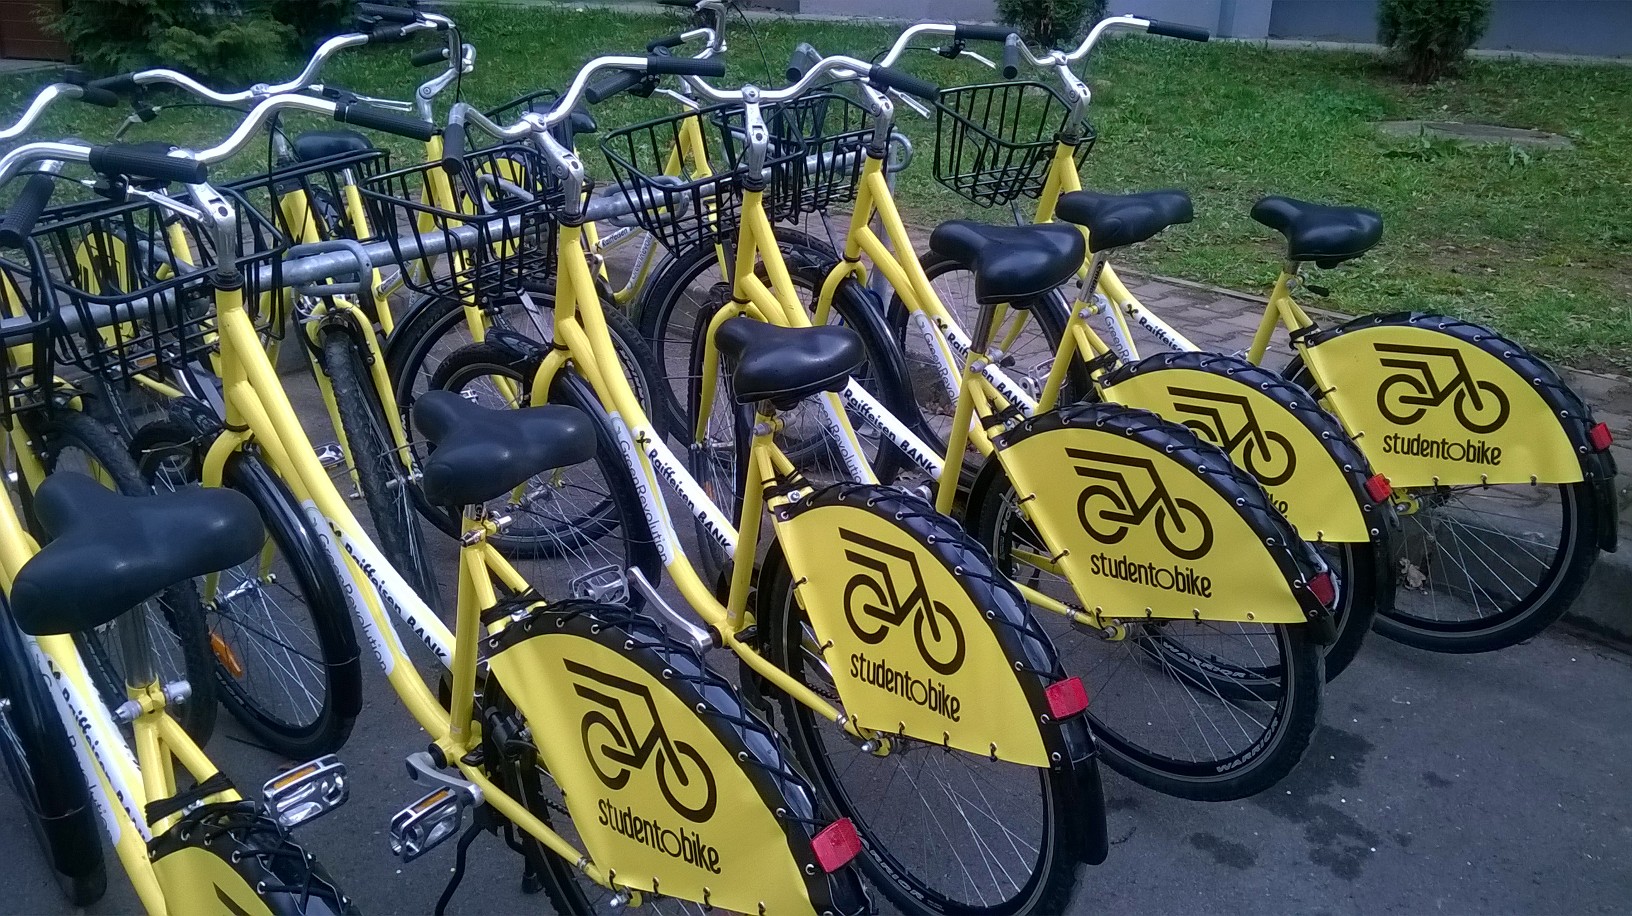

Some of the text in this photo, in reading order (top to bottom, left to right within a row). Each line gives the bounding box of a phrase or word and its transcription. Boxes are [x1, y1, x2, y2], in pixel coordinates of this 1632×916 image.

[996, 381, 1030, 415] BANK
[844, 388, 937, 475] Raiffeisen BANK
[1383, 433, 1502, 466] studentobike
[620, 440, 668, 564] GreenRevolution
[648, 448, 732, 549] Raiffeisen BANK
[1090, 552, 1212, 598] studentobike
[406, 615, 447, 660] BANK
[1163, 641, 1246, 678] WARRIOR
[850, 652, 961, 722] studentobike
[1216, 717, 1279, 773] WARRIOR
[598, 798, 722, 874] studentobike
